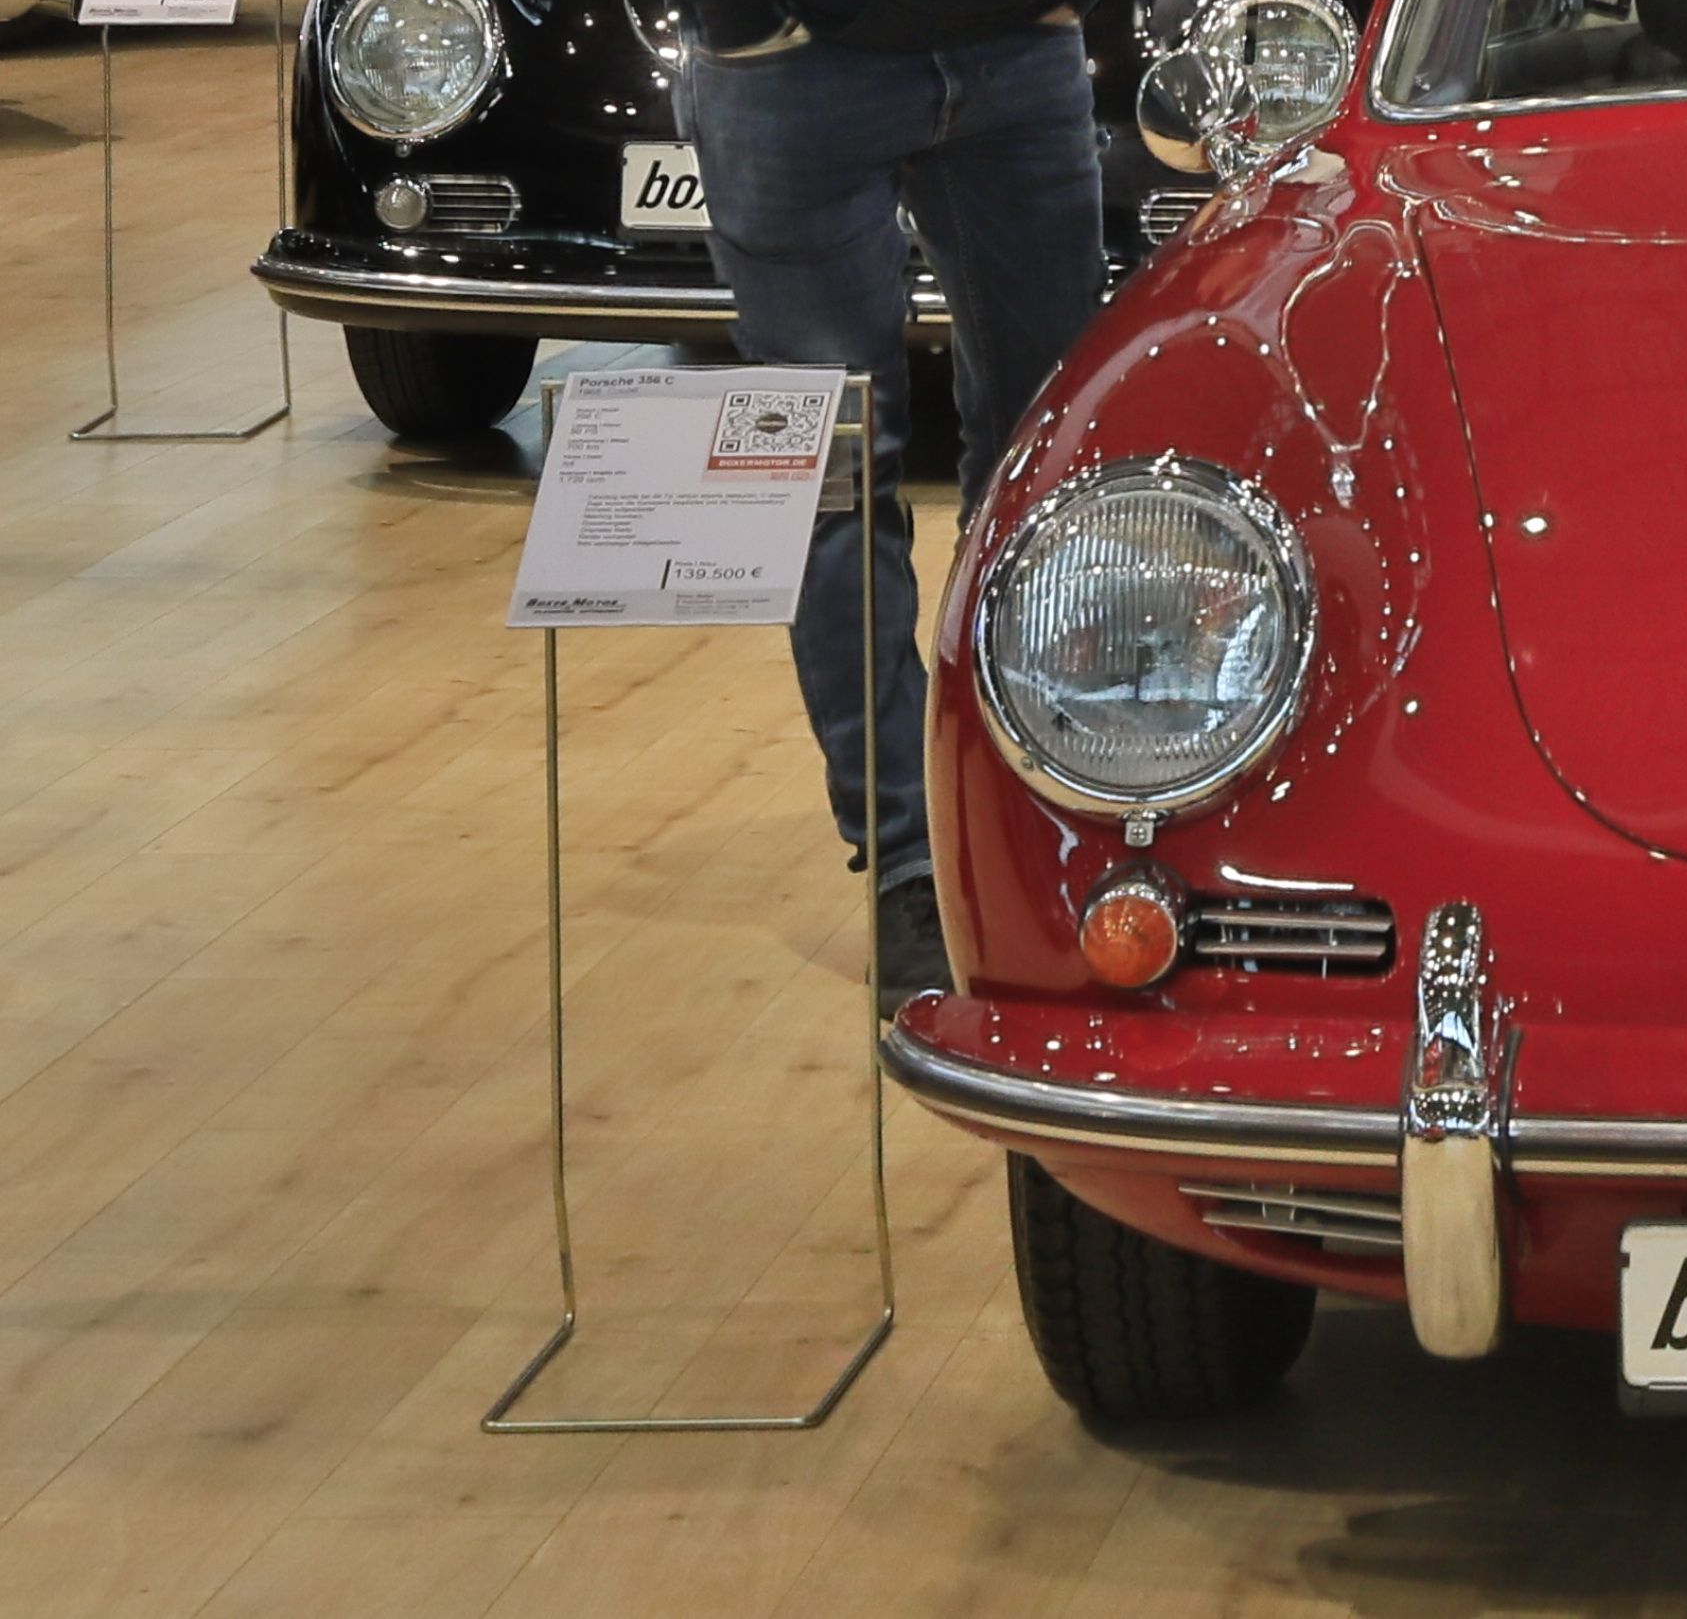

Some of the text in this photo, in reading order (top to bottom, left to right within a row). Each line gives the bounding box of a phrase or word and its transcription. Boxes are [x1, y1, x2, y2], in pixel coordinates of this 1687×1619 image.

[634, 160, 705, 210] bo
[580, 375, 675, 387] Porsche 356 C
[674, 566, 763, 580] 139.500 €
